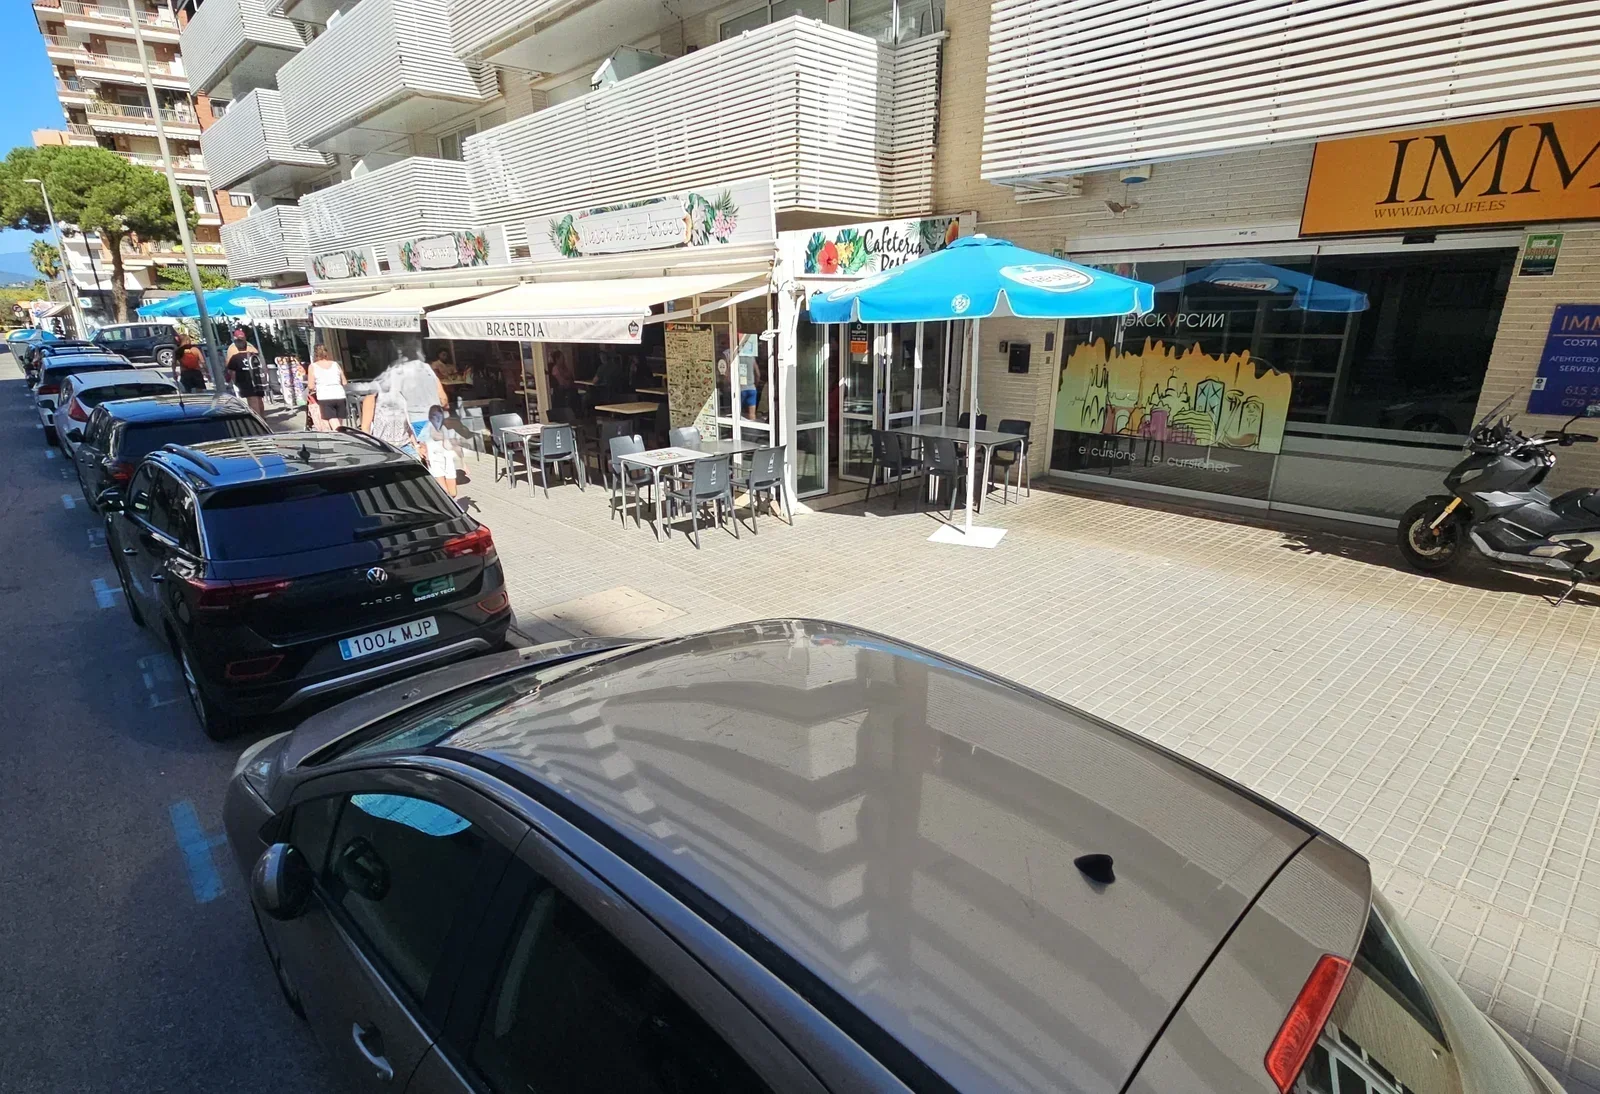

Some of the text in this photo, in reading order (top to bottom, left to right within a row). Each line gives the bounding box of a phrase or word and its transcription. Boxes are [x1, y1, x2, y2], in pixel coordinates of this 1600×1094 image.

[1373, 200, 1506, 219] WWW.IMMOLIFE.ES
[486, 321, 545, 338] BRASERIA
[1562, 338, 1598, 347] COSTA
[1559, 365, 1595, 373] SERVEIS
[1078, 446, 1137, 462] ecursions
[1152, 454, 1230, 474] ecursiones
[414, 586, 456, 603] ENERGY TECH
[354, 620, 432, 654] 1004 MJP
